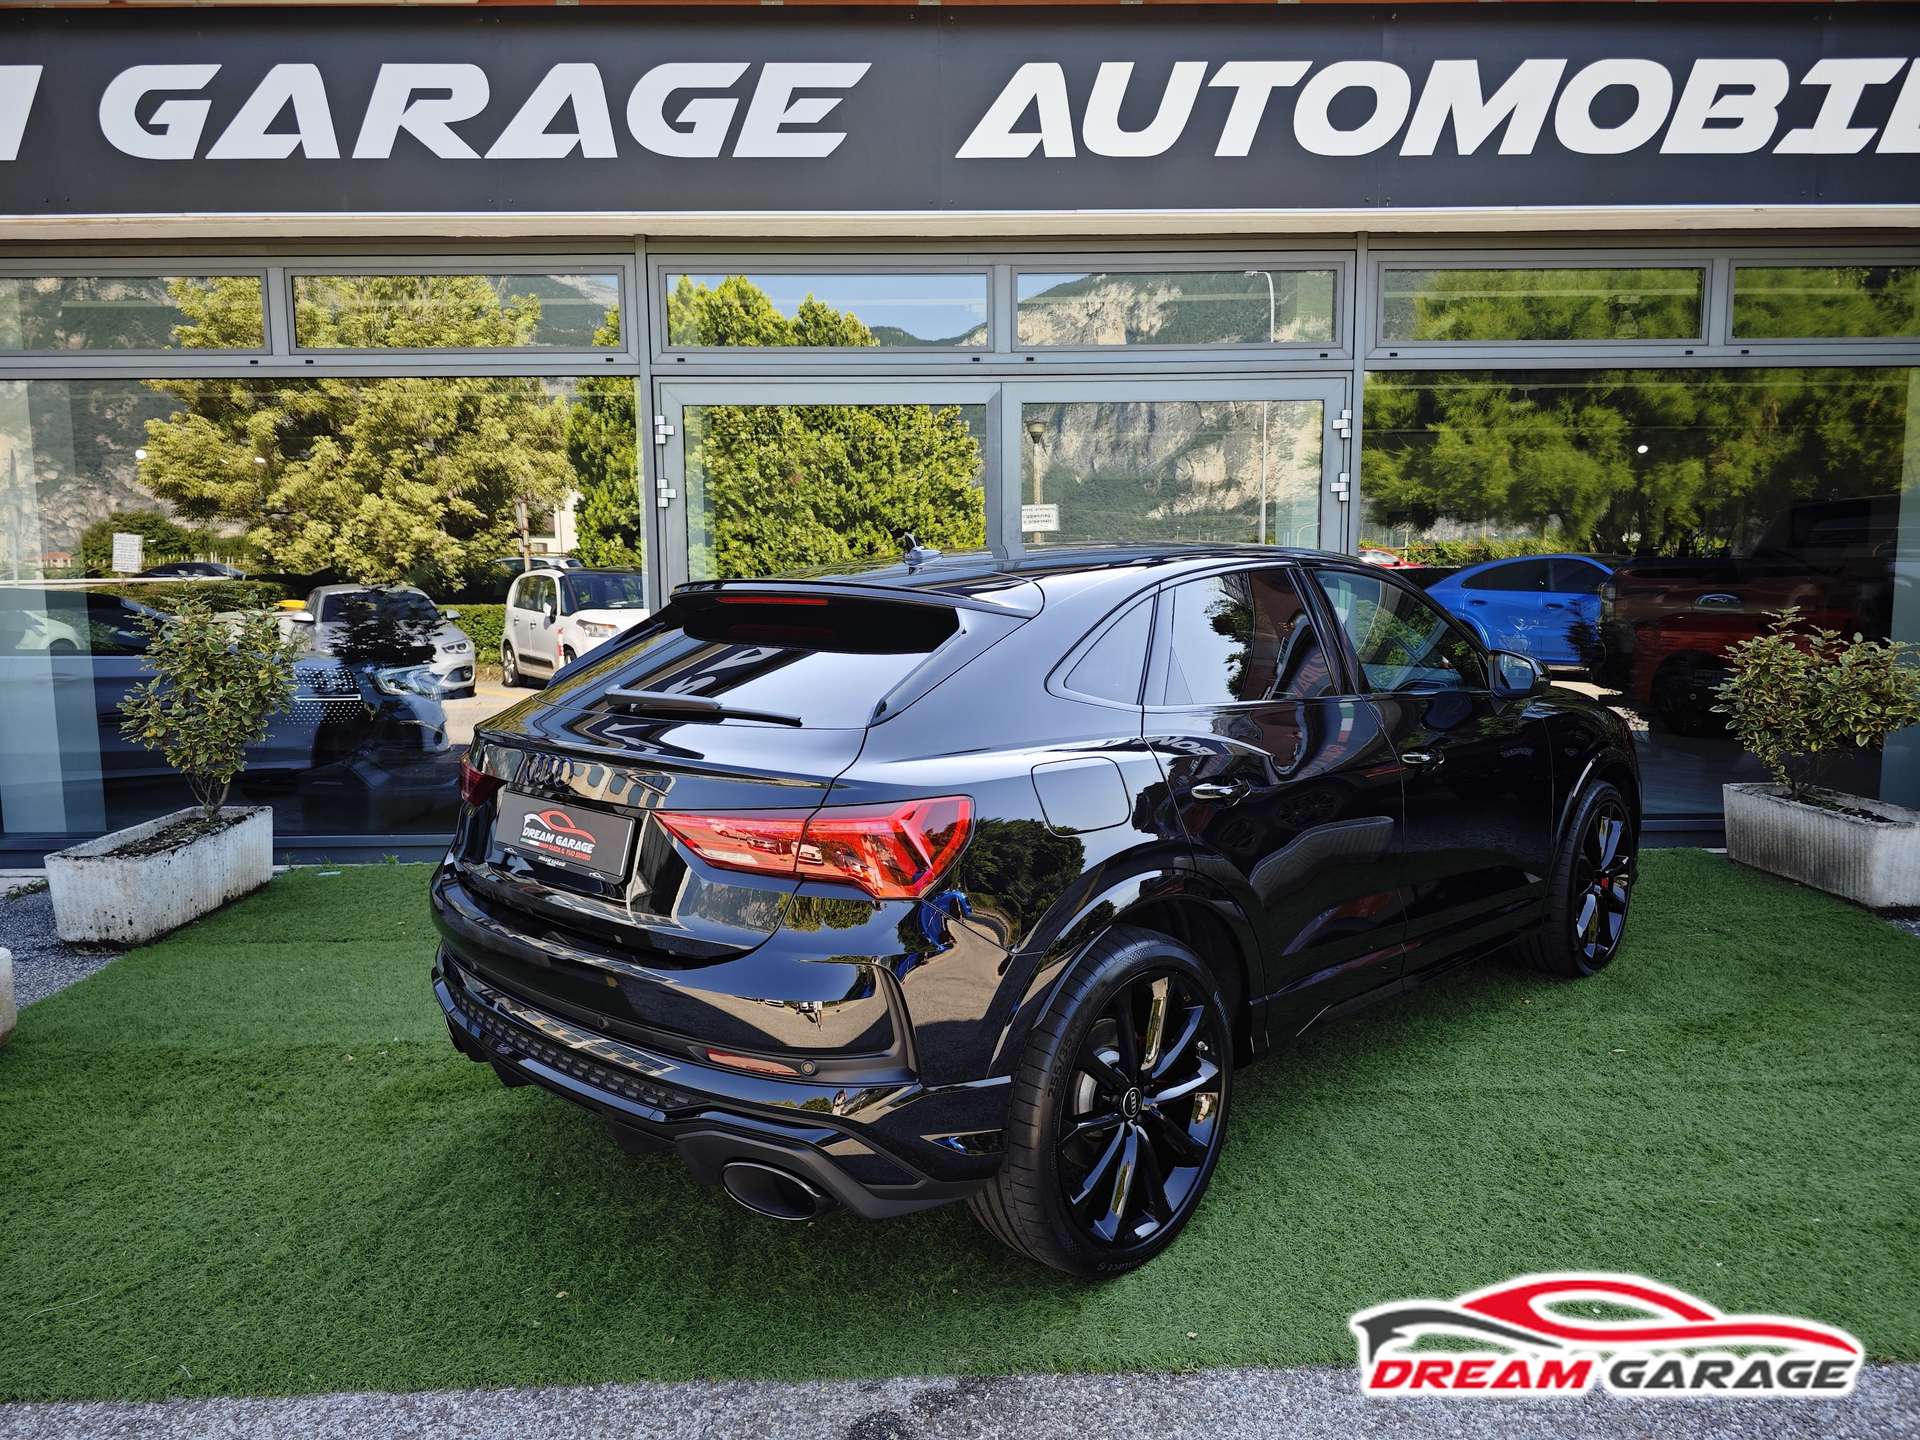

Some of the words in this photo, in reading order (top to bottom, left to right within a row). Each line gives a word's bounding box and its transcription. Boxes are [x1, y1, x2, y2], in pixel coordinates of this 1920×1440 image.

[98, 62, 873, 160] GARAGE
[522, 827, 555, 843] DREAM
[556, 835, 595, 854] GARAGE
